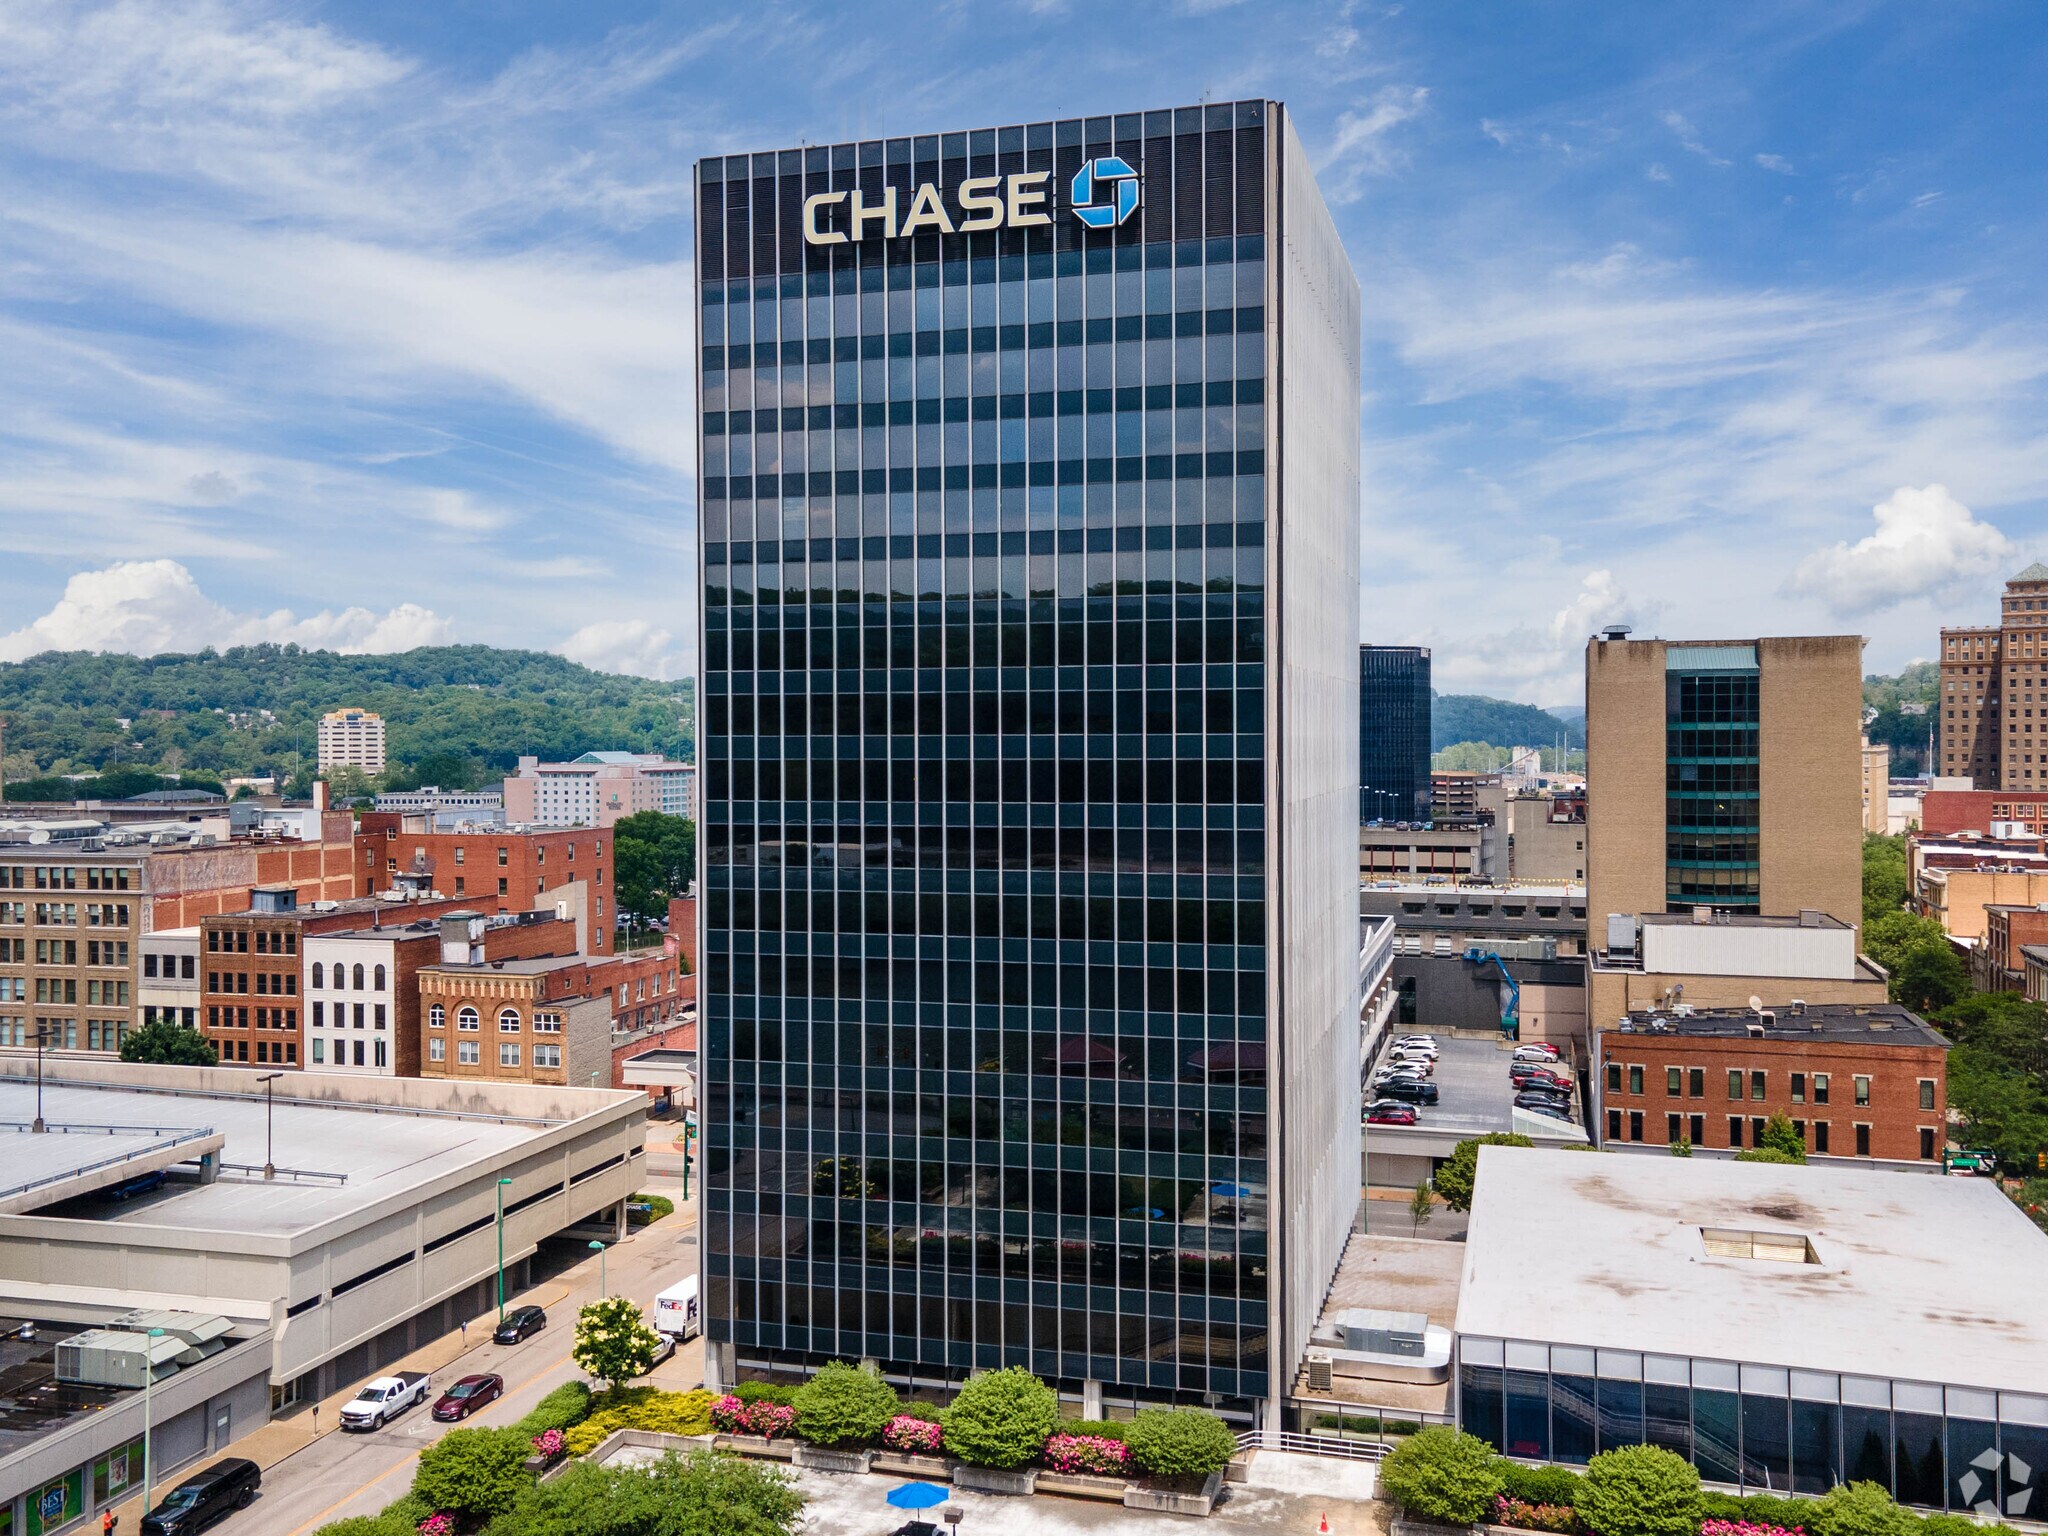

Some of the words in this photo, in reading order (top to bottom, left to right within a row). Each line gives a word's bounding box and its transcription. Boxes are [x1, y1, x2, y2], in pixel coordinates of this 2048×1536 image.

[803, 171, 1052, 245] CHASE
[661, 1301, 682, 1311] FedEx
[41, 1488, 65, 1512] BEST
